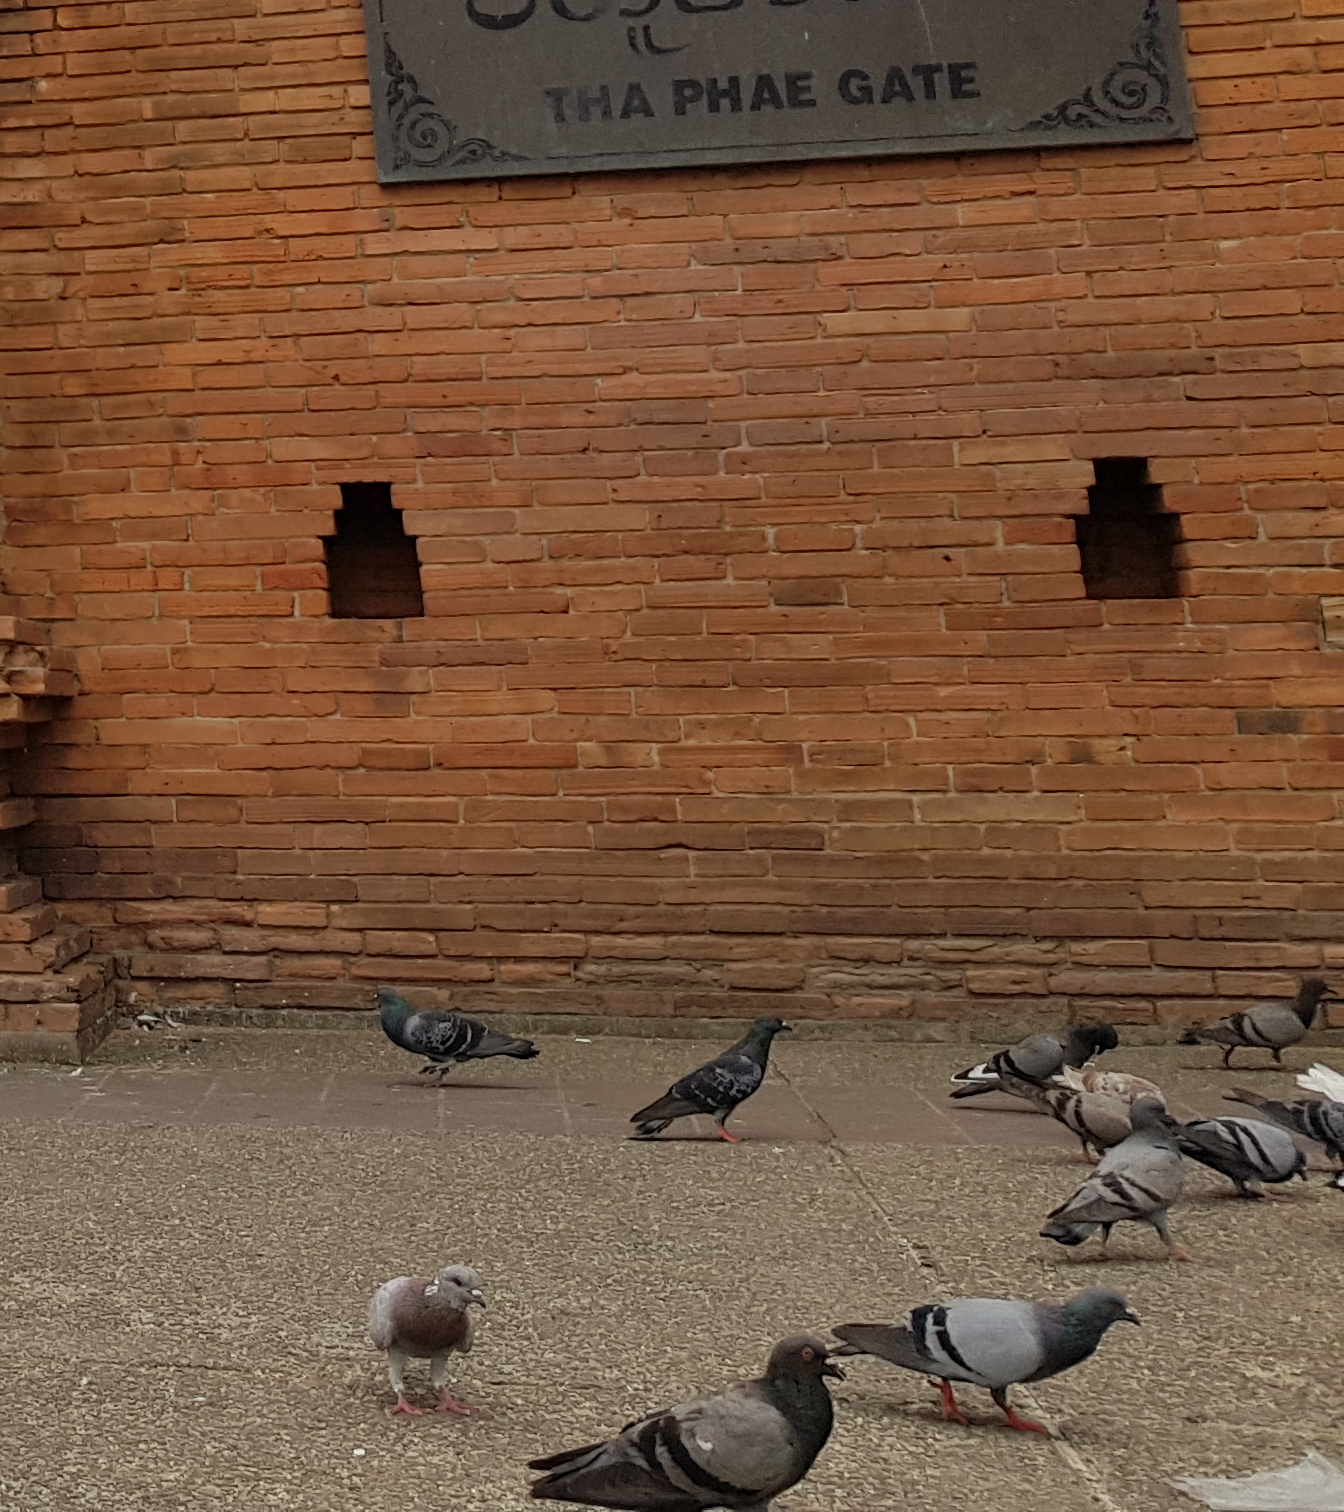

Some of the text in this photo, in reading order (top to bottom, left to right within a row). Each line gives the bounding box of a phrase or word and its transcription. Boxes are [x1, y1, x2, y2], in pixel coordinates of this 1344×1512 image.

[545, 61, 982, 124] THA PHAE GATE
